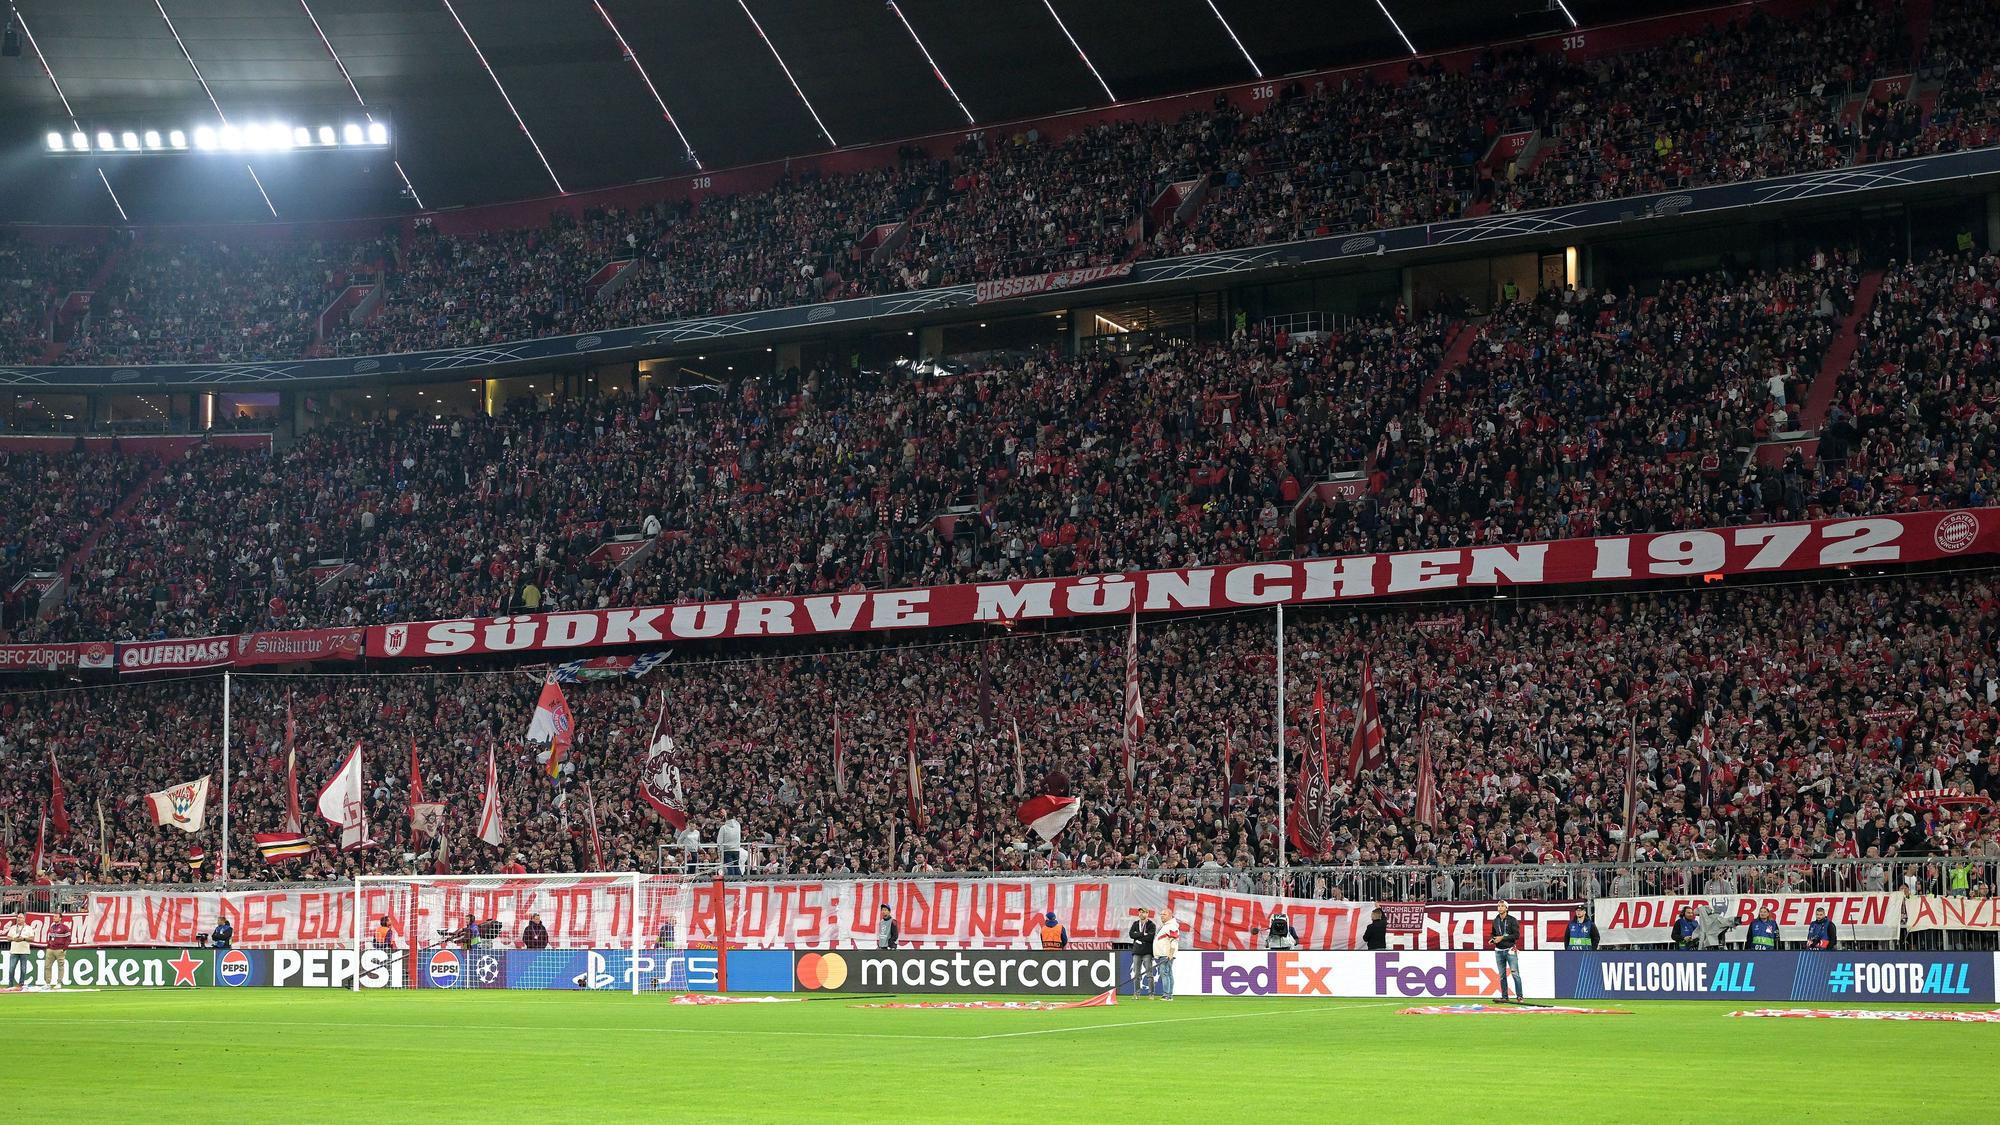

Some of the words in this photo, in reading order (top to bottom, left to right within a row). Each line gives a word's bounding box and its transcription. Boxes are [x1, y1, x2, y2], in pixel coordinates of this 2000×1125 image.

[1562, 35, 1585, 50] 315
[1252, 86, 1274, 100] 316
[1511, 138, 1525, 147] 315
[692, 177, 711, 190] 318
[976, 274, 1048, 303] GIESSEN
[424, 589, 930, 655] SÜDKURVE
[973, 543, 1548, 621] MÜNCHEN
[1592, 518, 1904, 578] 1972
[27, 648, 76, 664] ZÜRICH
[123, 640, 230, 667] QUEERPASS
[255, 636, 323, 654] Südkurve
[93, 896, 132, 942] ZU
[145, 895, 208, 943] VIEL
[220, 893, 287, 943] DES
[297, 887, 407, 942] GUTEN
[550, 888, 592, 937] TO
[969, 883, 1056, 937] NEW
[1737, 895, 1891, 926] BRETTEN
[223, 963, 248, 973] PEPSI
[273, 949, 403, 987] PEPSI
[431, 964, 459, 975] PEPSI
[624, 957, 719, 984] PS5
[861, 951, 1116, 988] mastercard
[1201, 952, 1333, 995] FedEx
[1375, 952, 1515, 996] FedEx
[1601, 961, 1707, 992] WELCOME
[1710, 962, 1756, 992] ALL
[1828, 963, 1971, 994] #FOOTBALL
